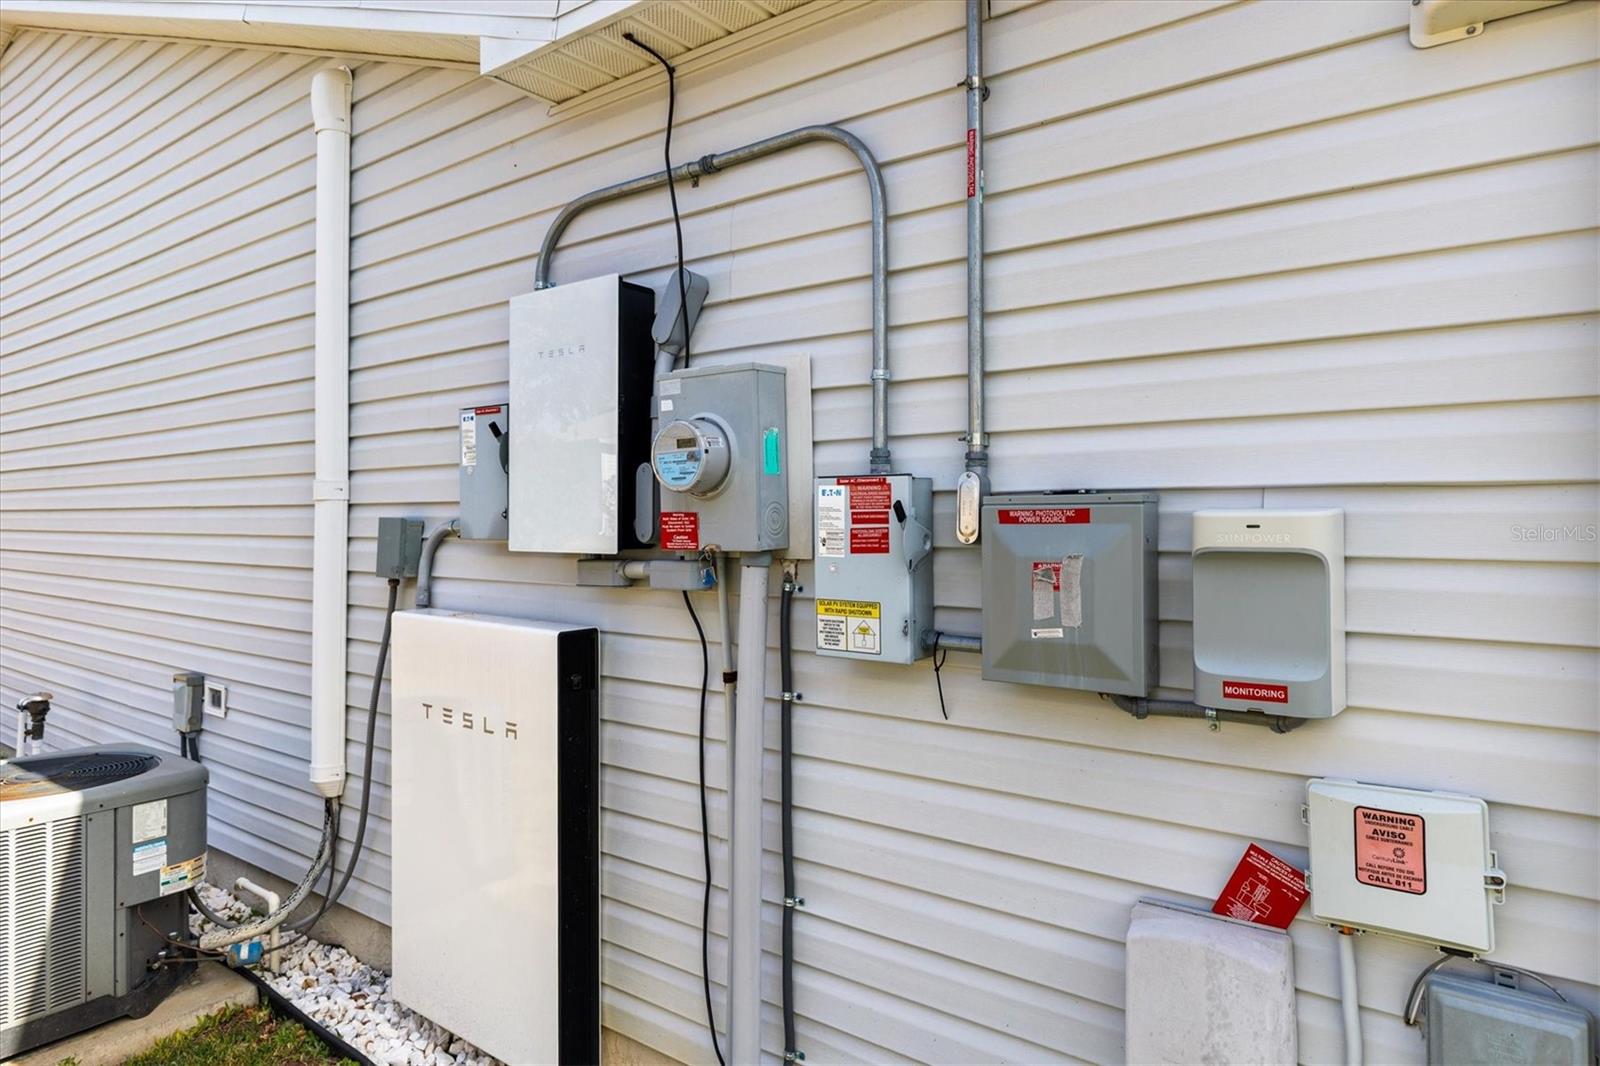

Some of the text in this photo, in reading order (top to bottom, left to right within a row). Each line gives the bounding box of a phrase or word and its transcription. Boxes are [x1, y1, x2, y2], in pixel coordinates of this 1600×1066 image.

[538, 344, 585, 358] TESLA
[1216, 534, 1292, 544] SUNPOWER
[1225, 686, 1286, 699] MONITORING
[422, 703, 518, 740] TESLA
[1362, 811, 1416, 826] WARNING
[1364, 820, 1398, 829] UNDERGROUND
[1372, 828, 1406, 840] AVISO
[1372, 854, 1405, 865] CenturyLink
[1358, 867, 1380, 875] NOTIFIQUE
[1377, 864, 1394, 872] BEFORE
[1368, 874, 1412, 888] CALL 811
